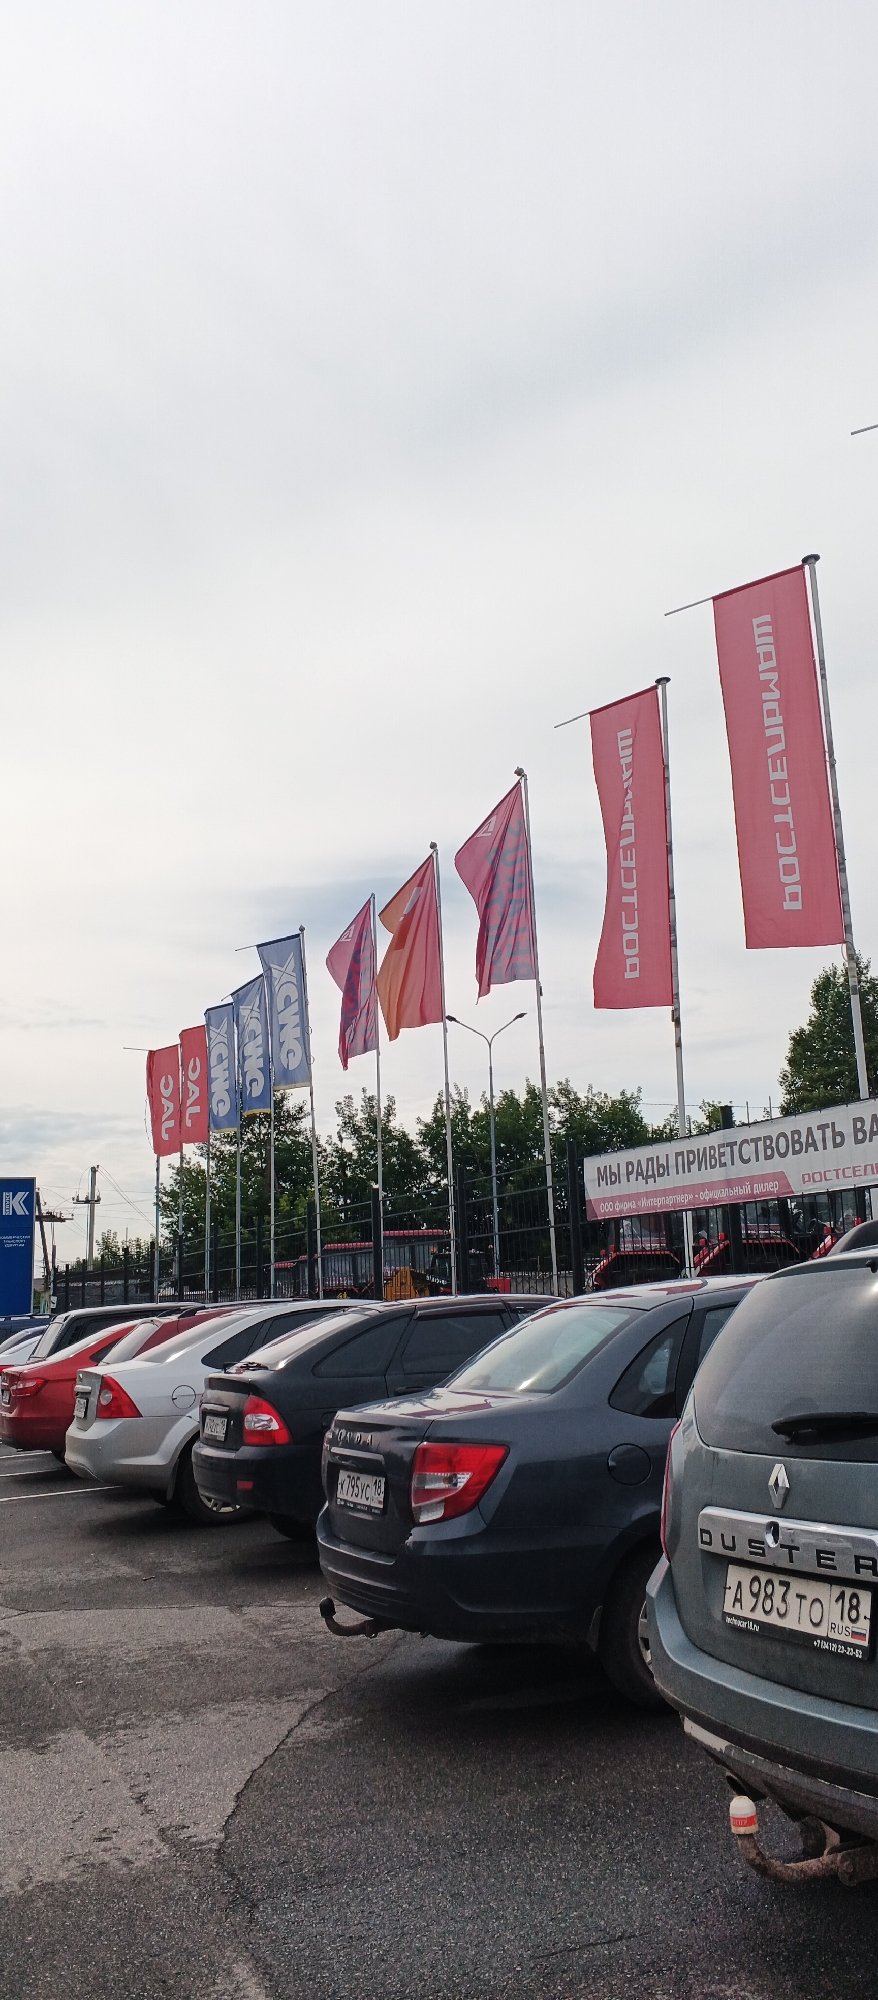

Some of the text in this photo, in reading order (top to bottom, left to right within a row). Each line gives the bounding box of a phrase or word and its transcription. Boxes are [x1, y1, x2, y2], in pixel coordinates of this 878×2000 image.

[270, 951, 303, 1071] XCMG
[239, 984, 265, 1098] XCMG
[209, 1016, 231, 1118] XCMG
[596, 1163, 622, 1187] МЫ
[625, 1153, 670, 1184] РАДЫ
[674, 1122, 846, 1175] ПРИВЕТСТВОВАТЬ
[802, 1162, 878, 1184] РОСТСЕЛ
[600, 1201, 614, 1213] ООО
[614, 1200, 636, 1213] фирма
[637, 1193, 694, 1208] «Интерпартнер»
[699, 1182, 751, 1202] официальный
[753, 1180, 779, 1195] дилер
[699, 1527, 878, 1578] DUSTER
[829, 1622, 851, 1637] RUS
[834, 1589, 861, 1624] 18
